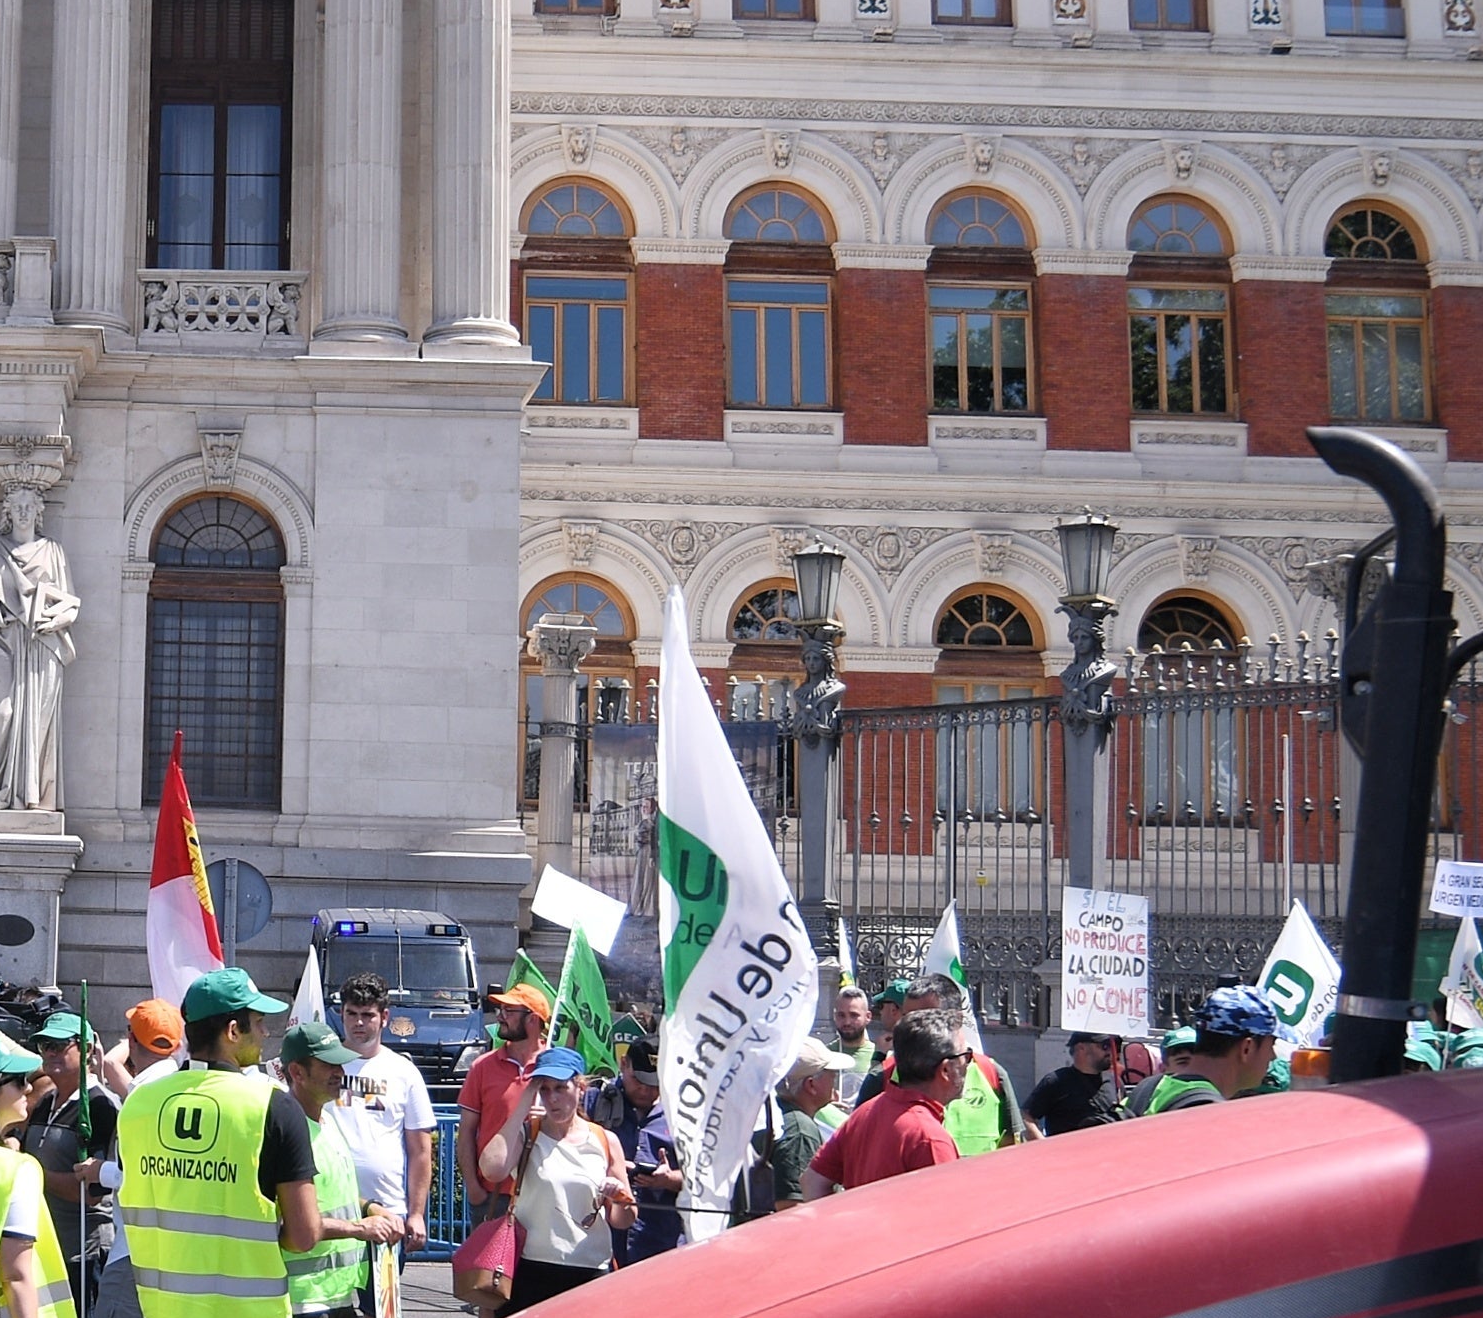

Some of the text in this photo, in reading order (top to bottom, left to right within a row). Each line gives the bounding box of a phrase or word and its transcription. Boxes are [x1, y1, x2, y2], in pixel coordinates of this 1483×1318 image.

[1078, 911, 1124, 932] CAMPO
[1064, 928, 1147, 955] NO PRODUCE
[1068, 954, 1145, 977] LA CIUDAD
[1066, 986, 1147, 1018] NO COME
[175, 1106, 202, 1141] u
[140, 1155, 238, 1184] ORGANIZACIÓN
